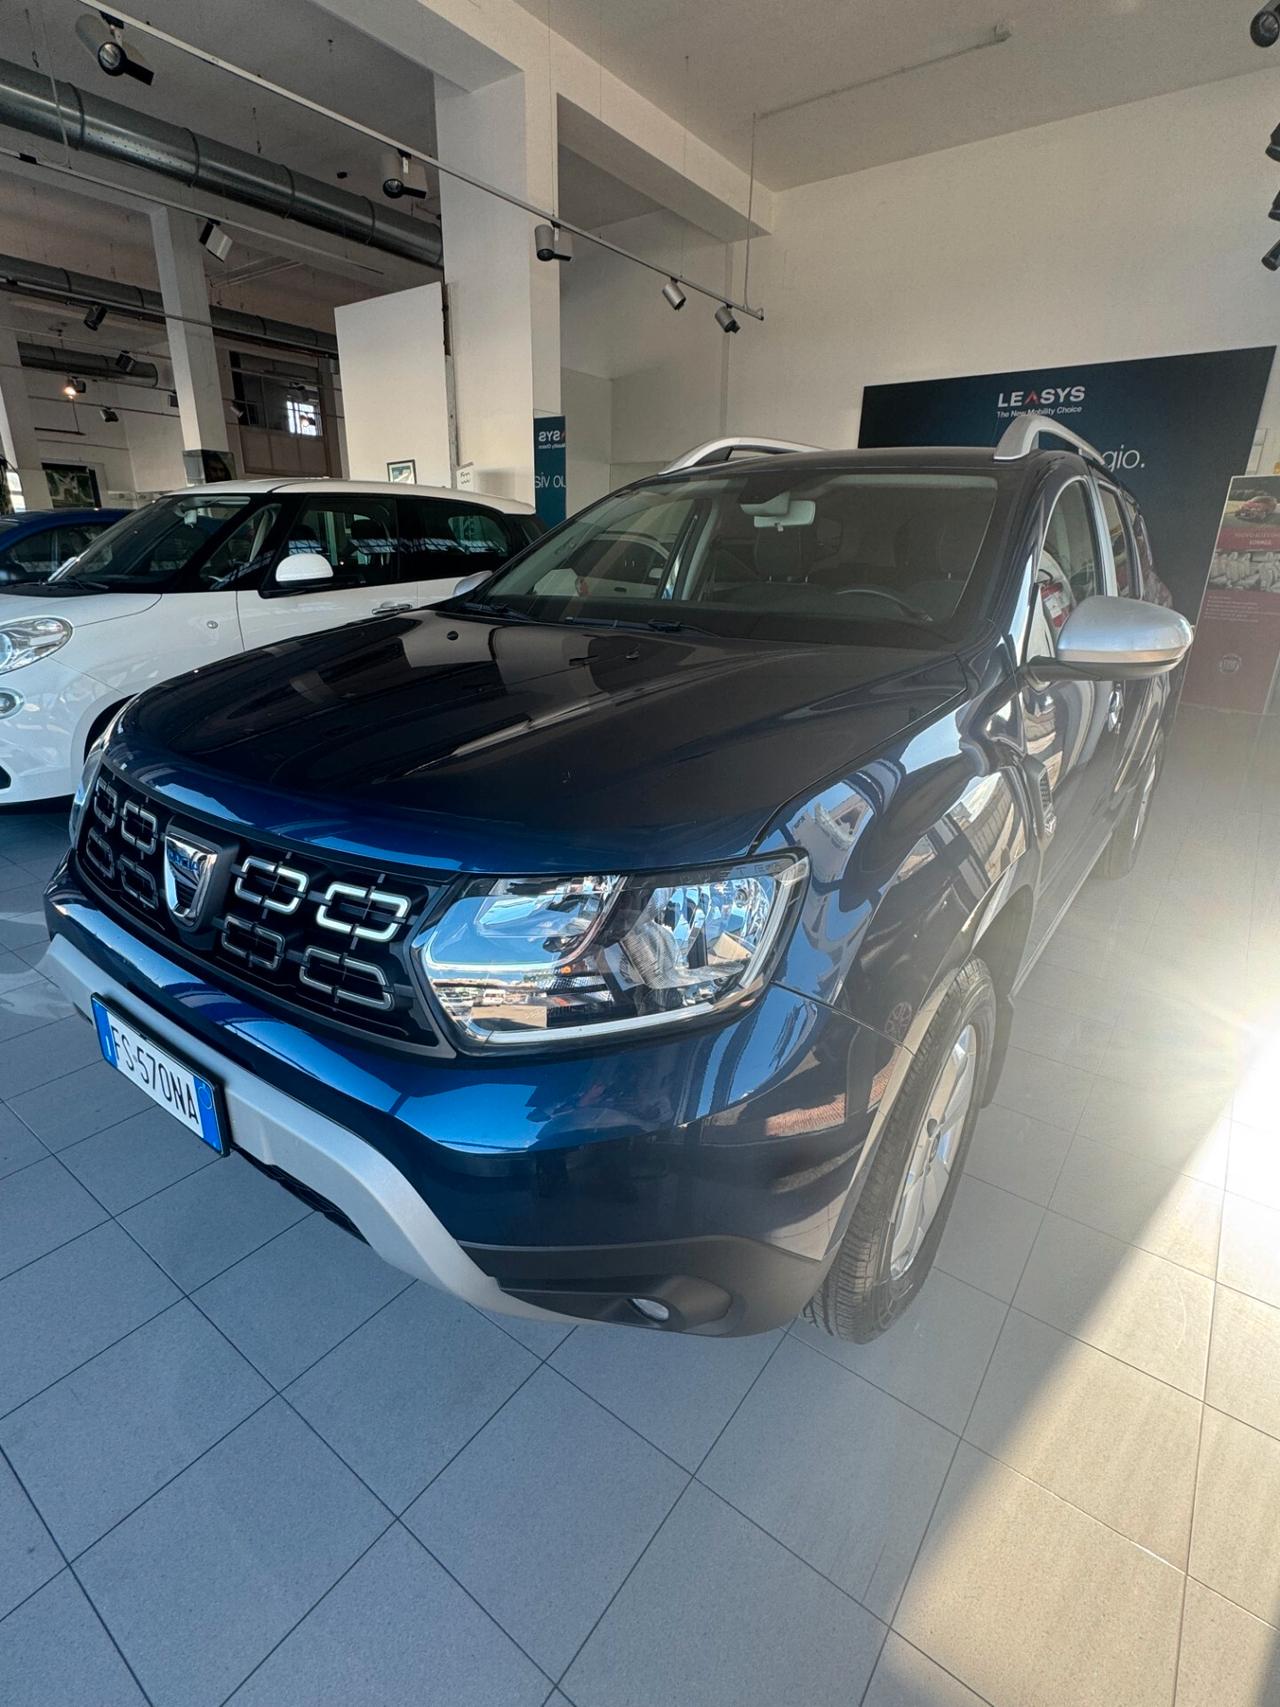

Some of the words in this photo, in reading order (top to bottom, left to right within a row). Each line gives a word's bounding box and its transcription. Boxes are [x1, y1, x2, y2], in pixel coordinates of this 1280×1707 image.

[997, 385, 1086, 408] LEASYS
[996, 410, 1010, 419] The
[1056, 405, 1083, 415] Choice
